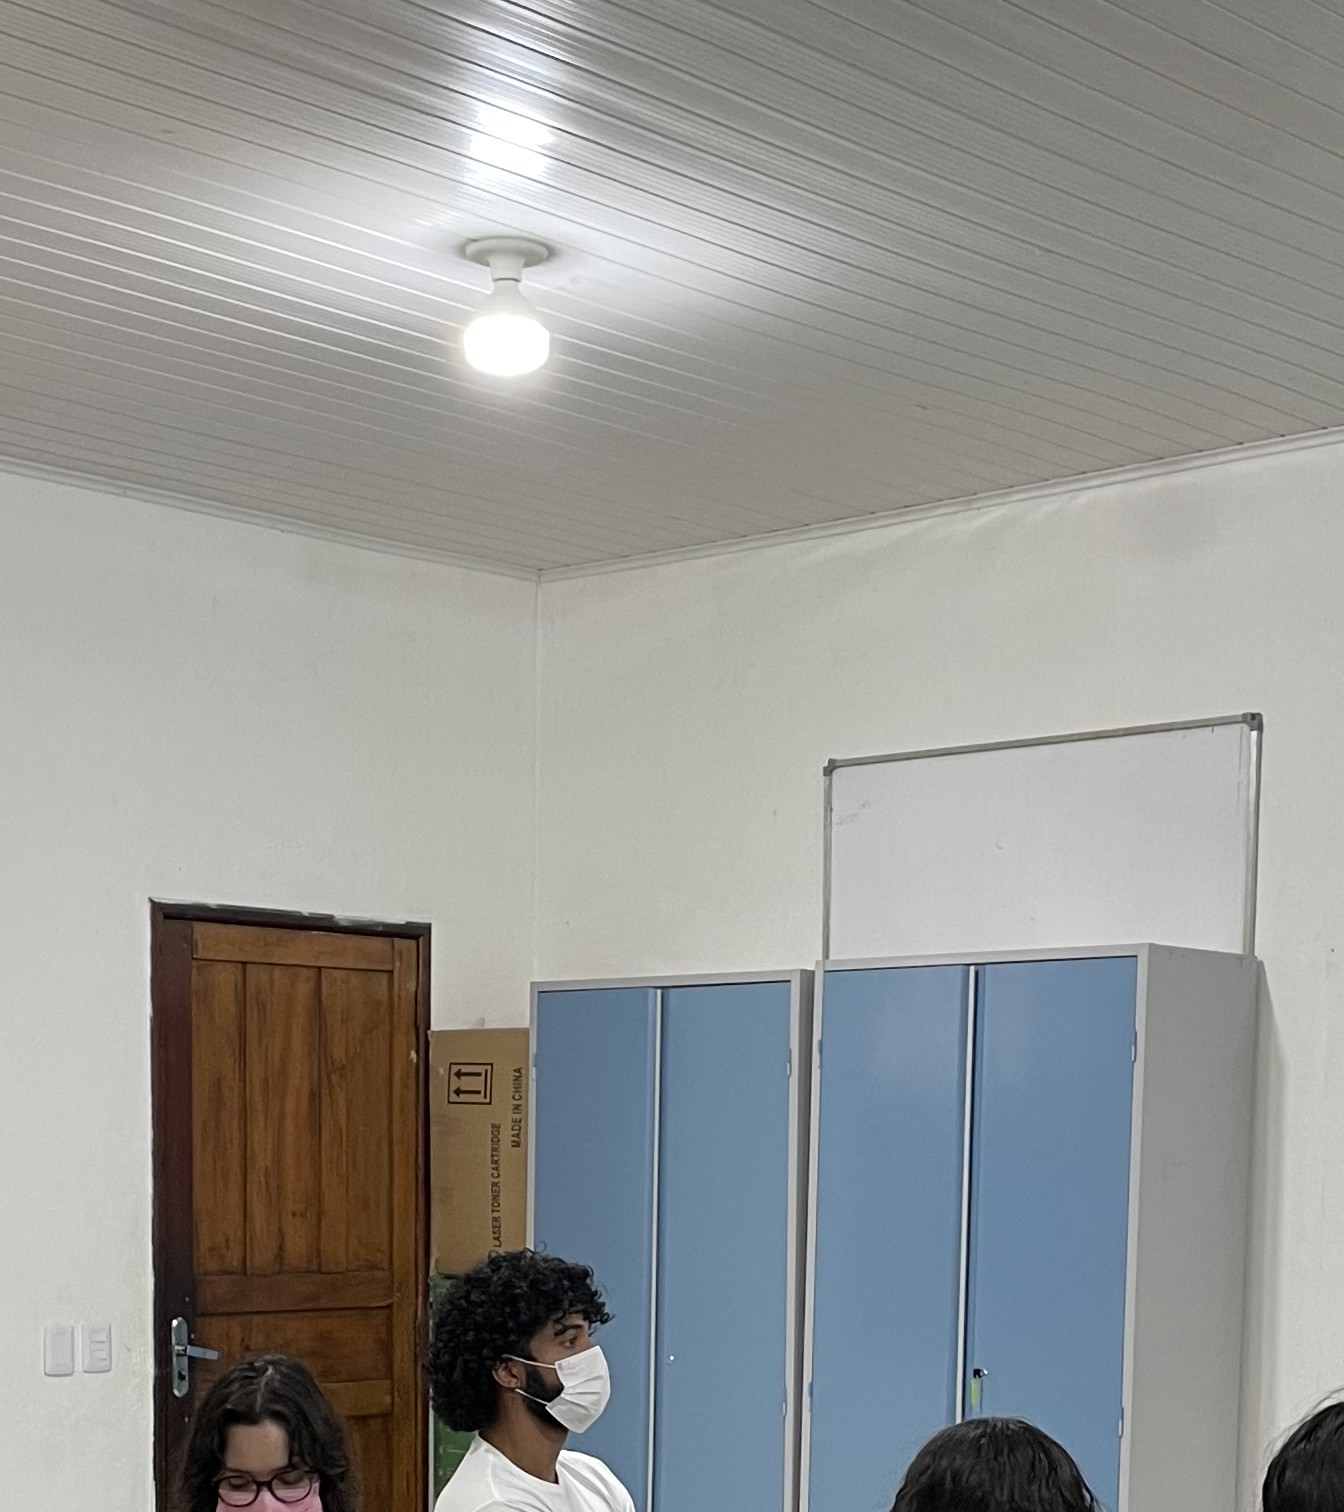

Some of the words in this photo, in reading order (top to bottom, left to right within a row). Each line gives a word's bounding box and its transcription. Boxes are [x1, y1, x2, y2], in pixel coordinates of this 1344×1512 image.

[513, 1067, 524, 1101] CHINA
[513, 1103, 523, 1115] IN
[511, 1118, 521, 1148] MADE
[490, 1122, 502, 1178] CARTRIDGE
[490, 1182, 501, 1214] TONER
[491, 1215, 502, 1248] LASER
